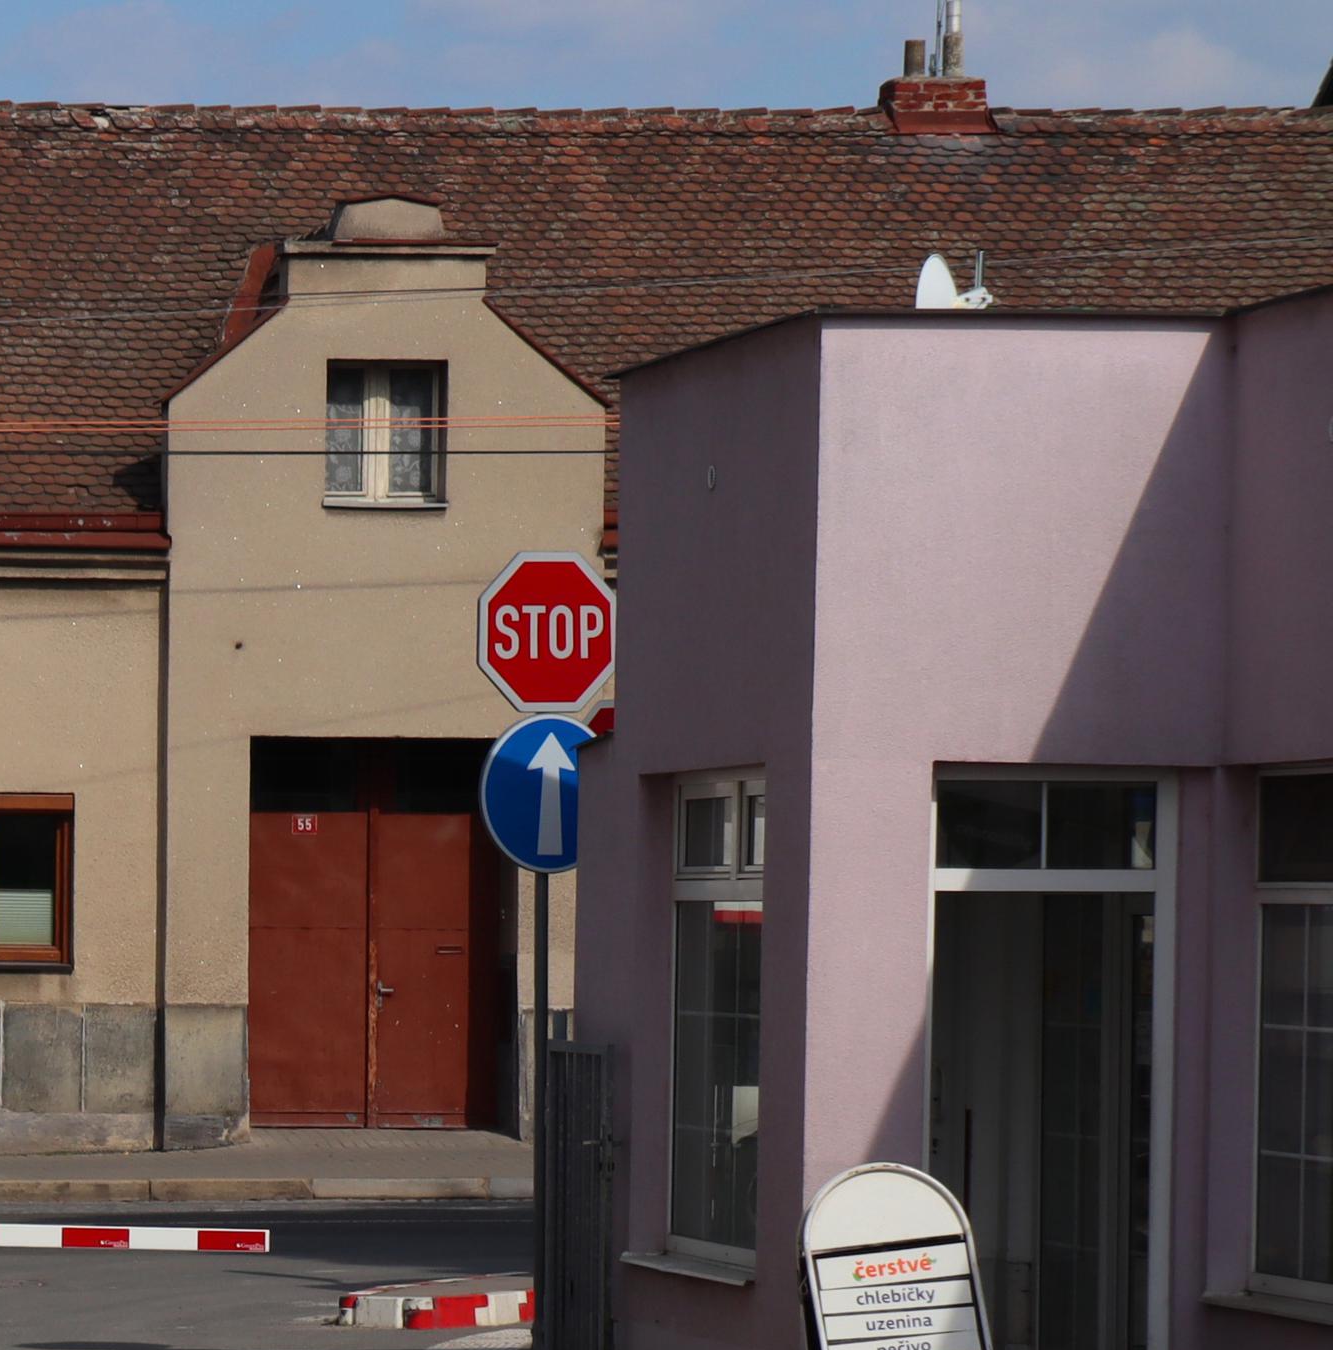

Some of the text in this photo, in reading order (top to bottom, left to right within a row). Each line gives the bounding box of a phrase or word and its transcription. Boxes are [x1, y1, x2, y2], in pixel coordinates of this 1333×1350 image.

[493, 604, 605, 660] STOP
[297, 817, 312, 831] 55
[854, 1252, 933, 1279] čerstvé
[865, 1314, 933, 1331] uzenina
